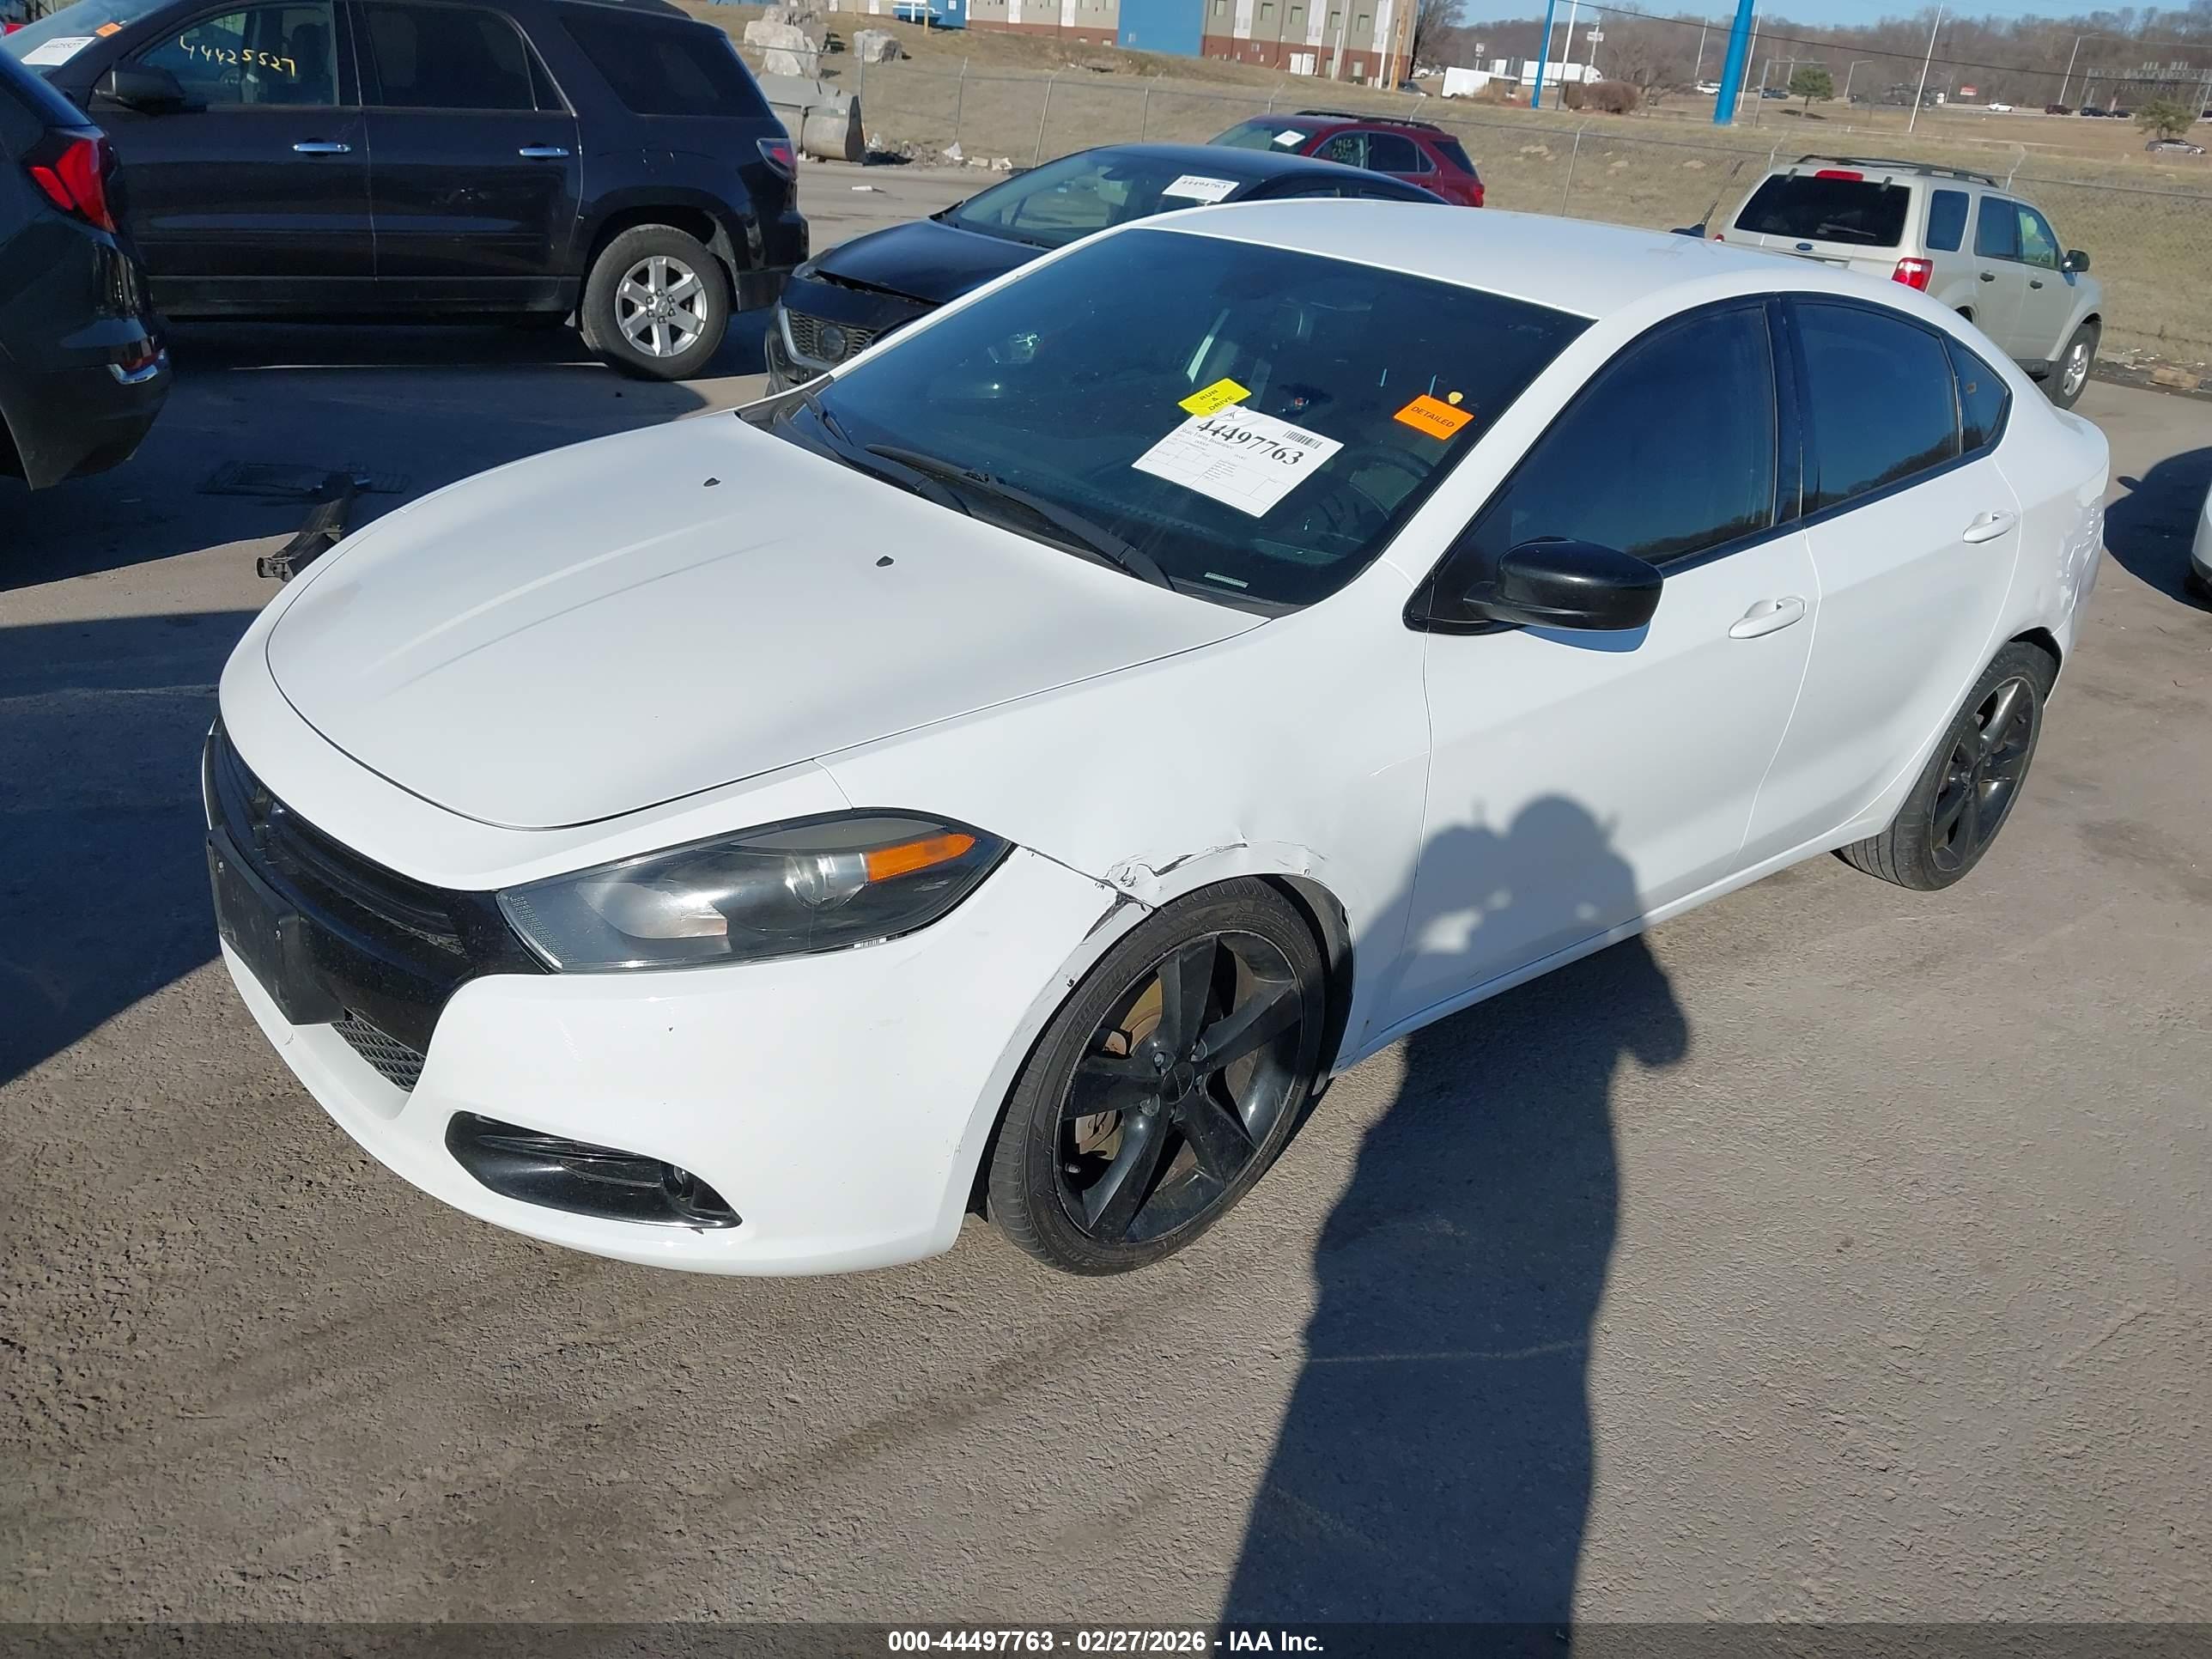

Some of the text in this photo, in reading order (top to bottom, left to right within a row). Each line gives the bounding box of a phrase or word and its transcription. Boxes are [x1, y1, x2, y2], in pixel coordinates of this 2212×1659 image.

[179, 35, 295, 78] 44425527
[1199, 389, 1219, 401] RUN
[1208, 395, 1235, 411] DRIVE
[1410, 406, 1455, 428] DETAILED
[1196, 419, 1304, 465] 44497763
